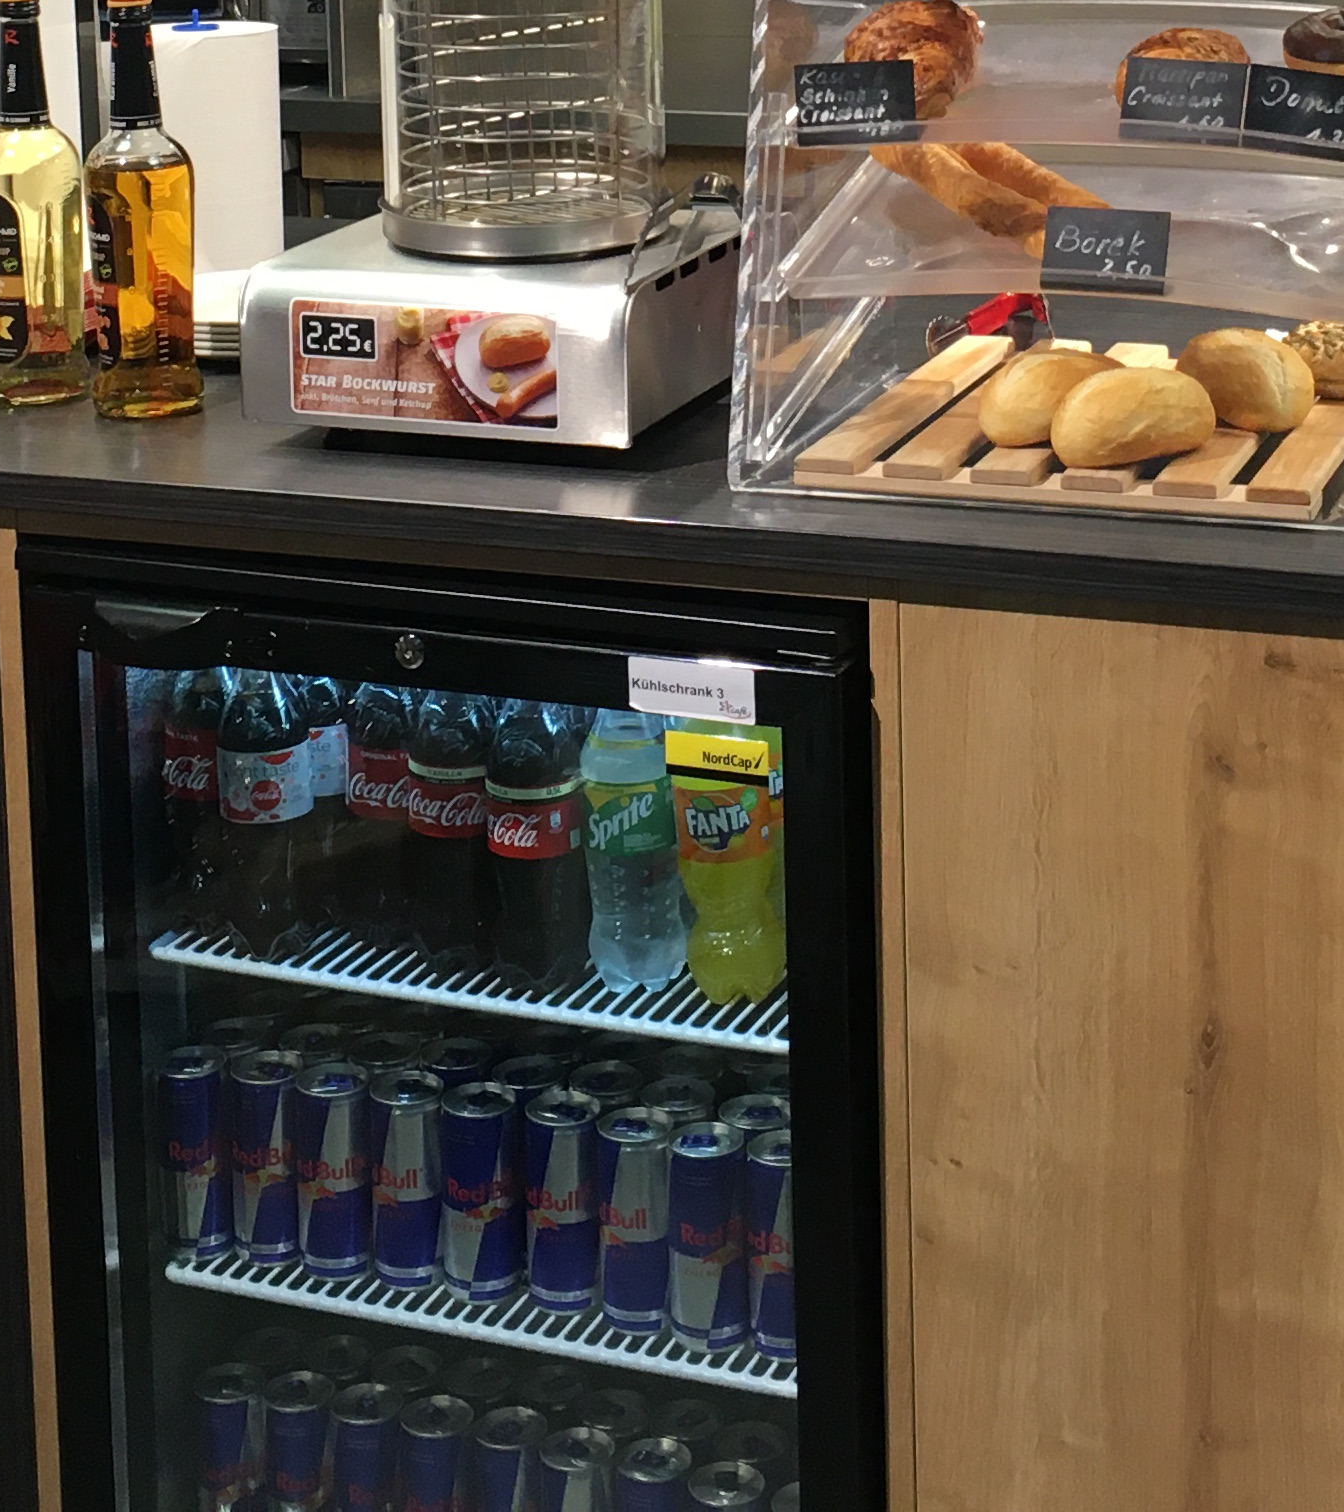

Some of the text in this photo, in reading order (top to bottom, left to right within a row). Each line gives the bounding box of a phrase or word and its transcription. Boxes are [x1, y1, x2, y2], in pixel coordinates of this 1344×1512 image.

[301, 374, 336, 387] STAR
[381, 397, 398, 406] und
[631, 677, 725, 699] Kühlschrank 3
[702, 751, 753, 771] NordCap
[588, 793, 655, 850] Sprite
[685, 804, 751, 837] FANTA
